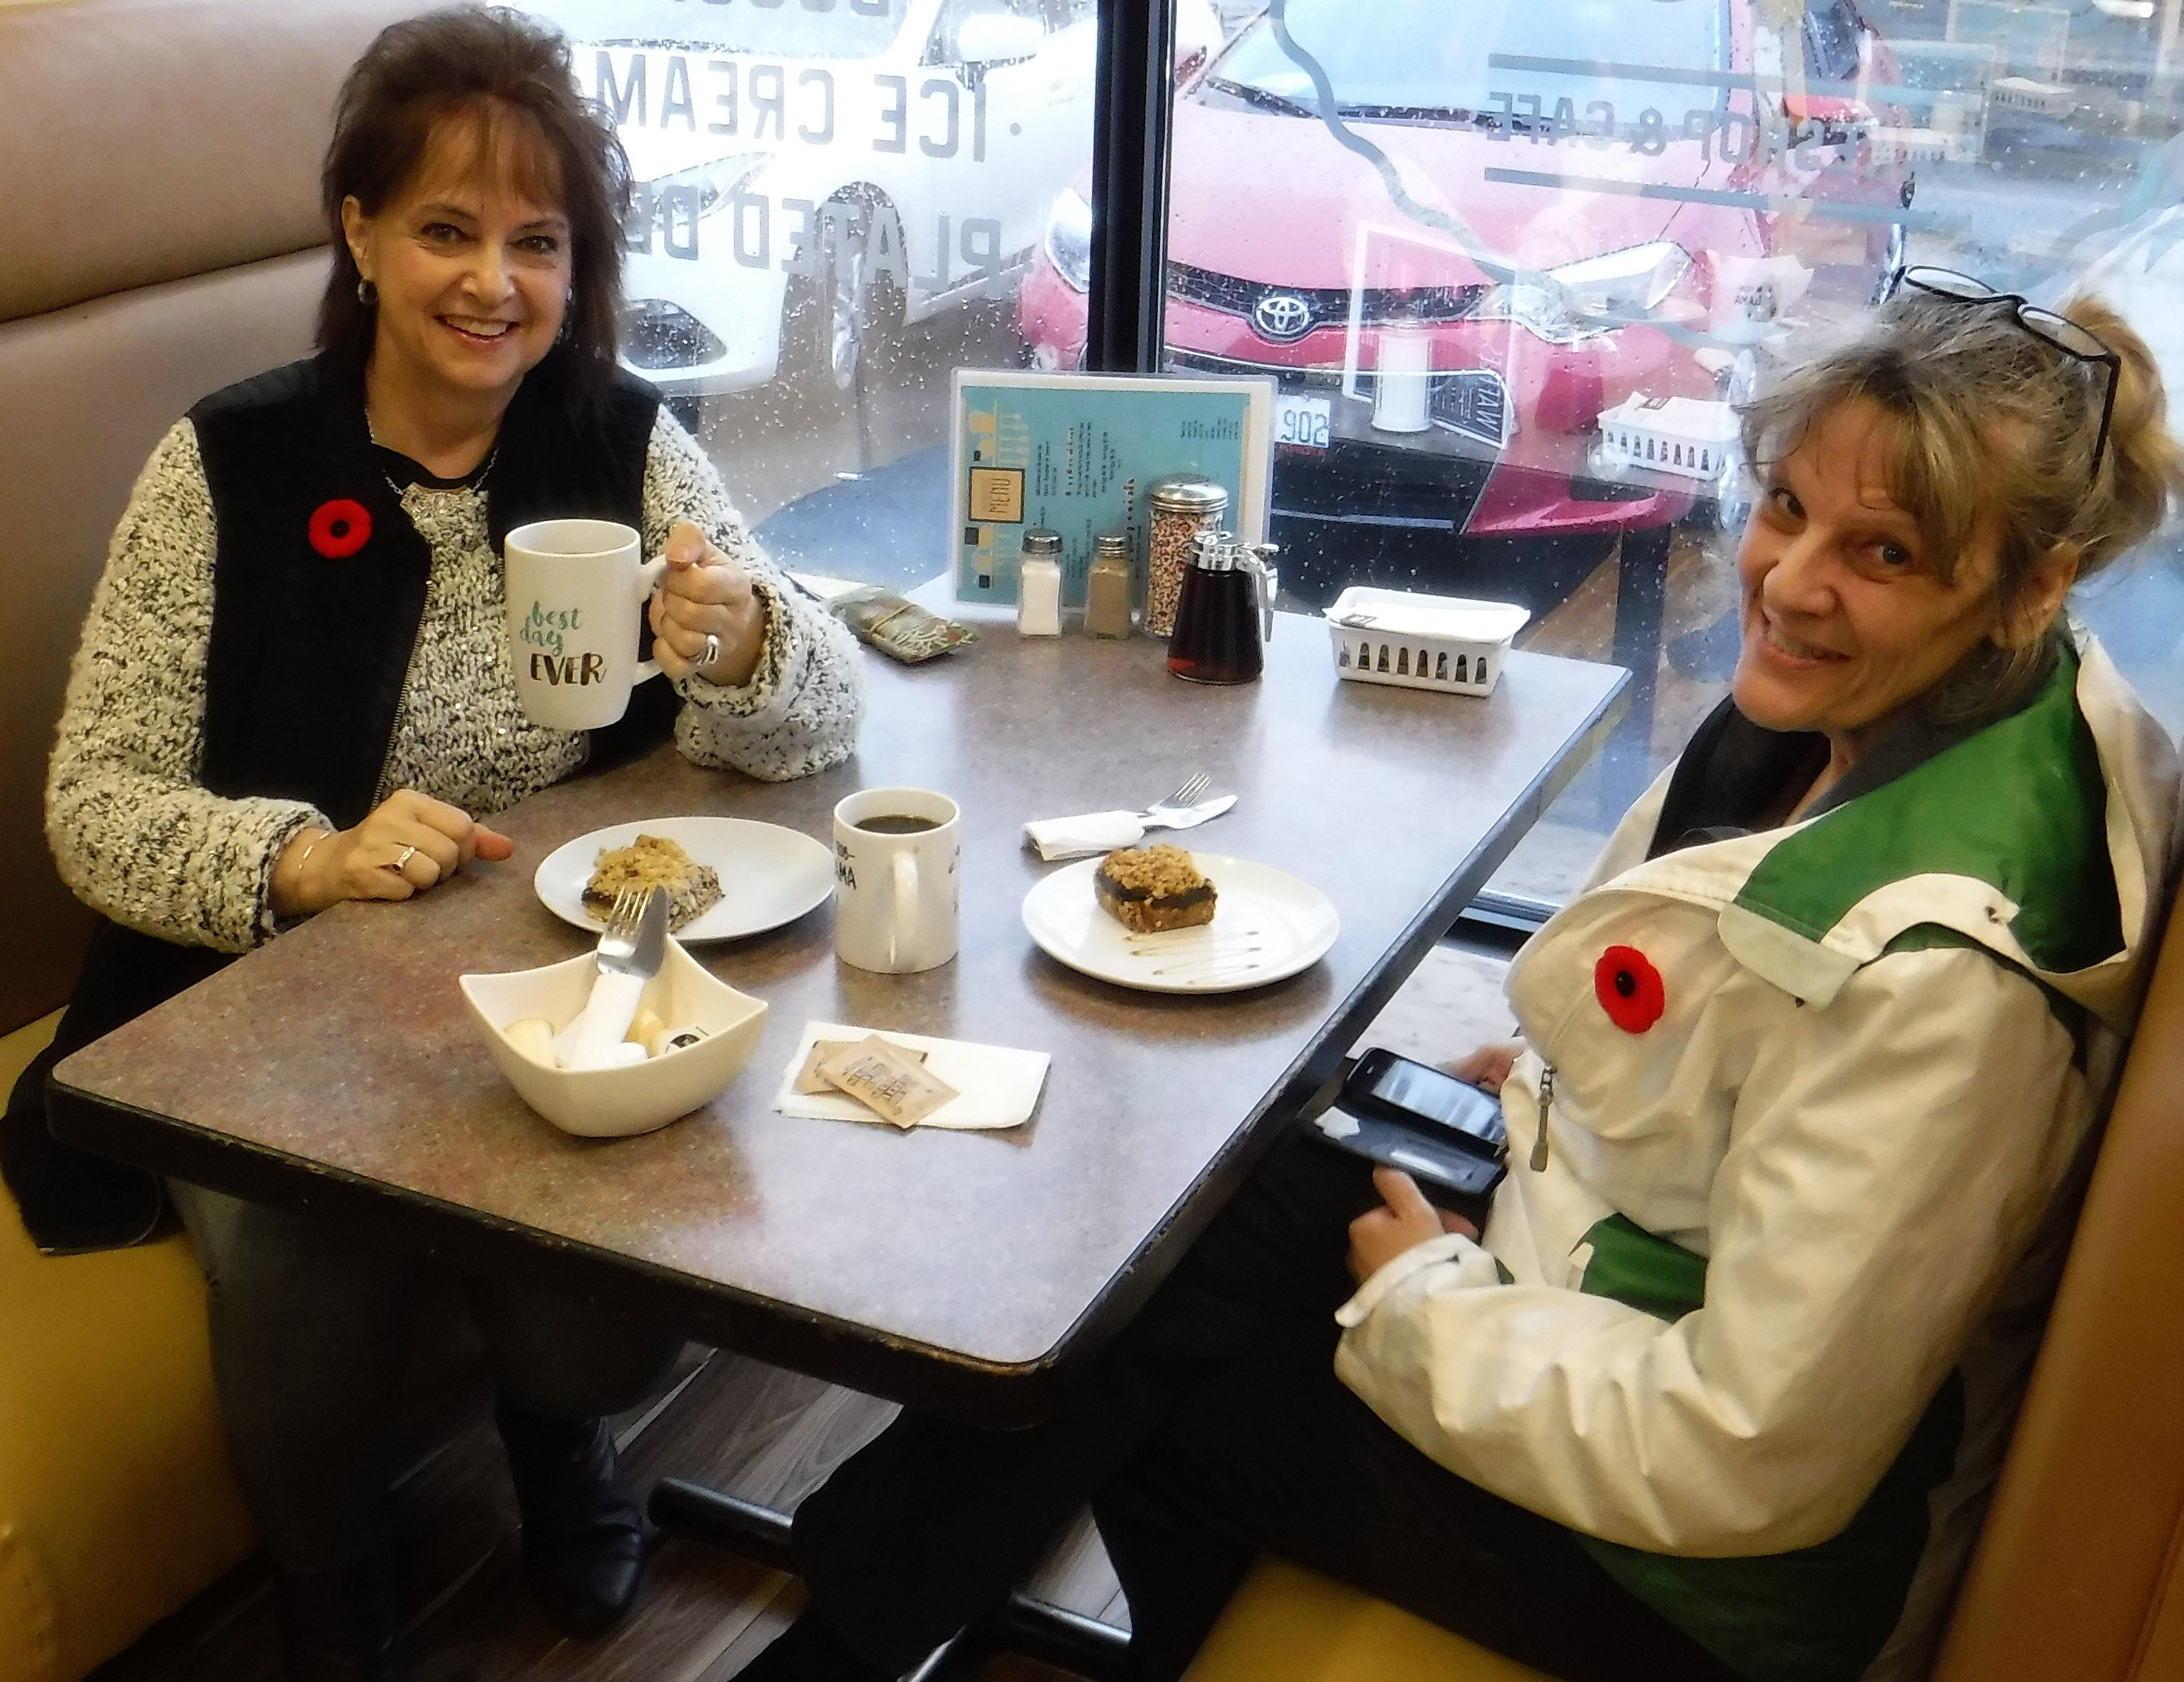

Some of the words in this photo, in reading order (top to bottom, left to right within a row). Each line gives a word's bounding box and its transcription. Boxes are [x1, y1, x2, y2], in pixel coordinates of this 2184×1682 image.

[989, 477, 1011, 514] MENU
[532, 601, 583, 630] best
[520, 616, 563, 657] day
[530, 652, 607, 686] EVER
